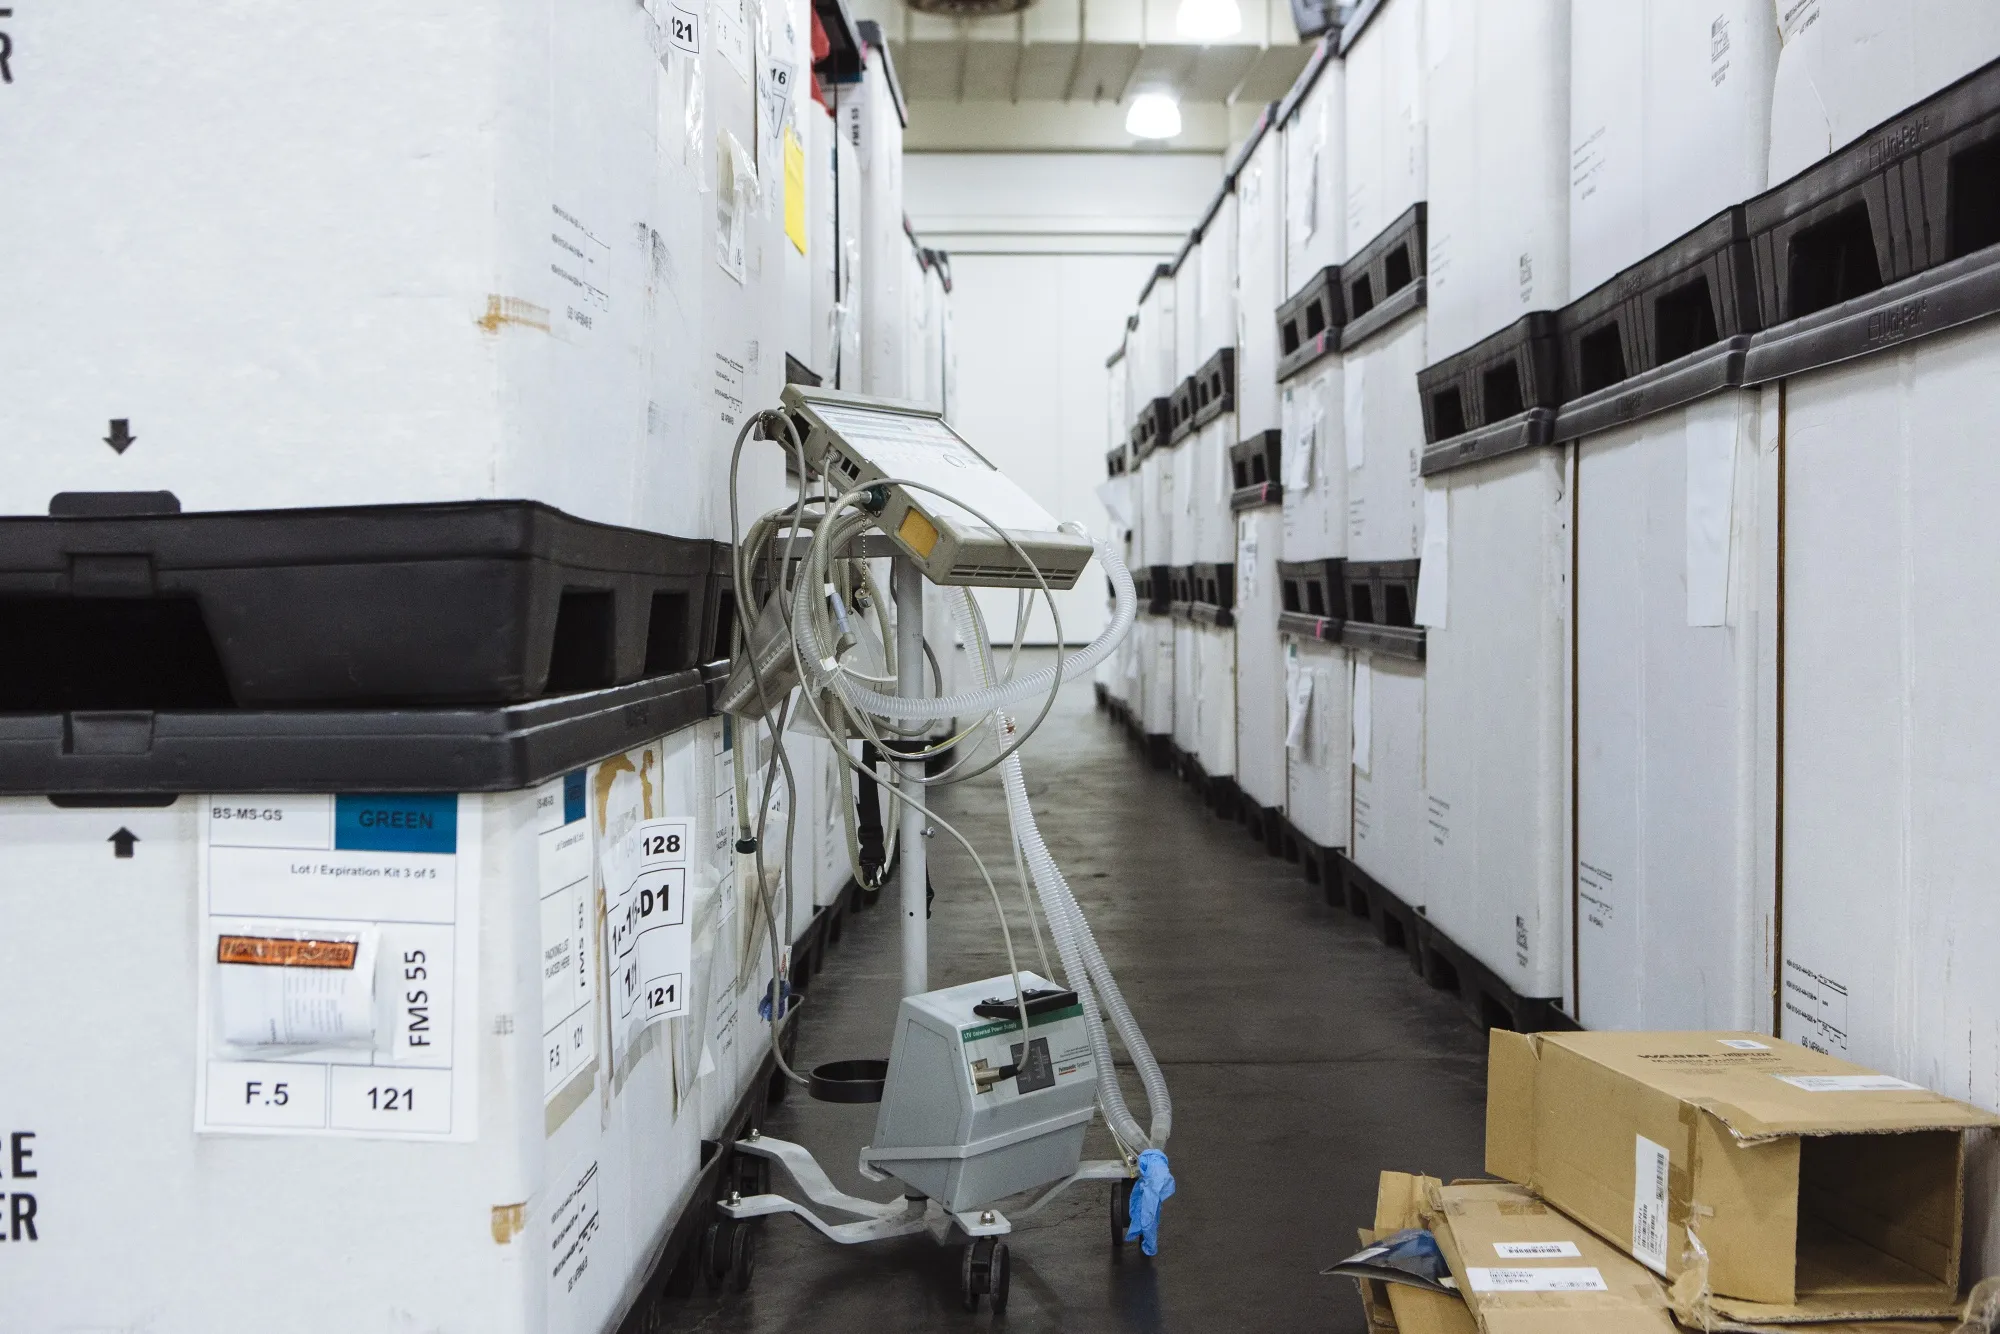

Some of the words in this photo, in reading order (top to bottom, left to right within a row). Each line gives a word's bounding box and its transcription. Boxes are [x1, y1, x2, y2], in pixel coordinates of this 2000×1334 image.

[671, 16, 693, 43] 121
[212, 806, 283, 822] BS-MS-GS
[358, 809, 433, 830] GREEN
[642, 834, 681, 857] 128
[290, 864, 310, 875] Lot
[320, 865, 380, 878] Expiration
[383, 867, 400, 878] Kit
[403, 868, 411, 878] 3
[413, 868, 426, 878] of
[404, 949, 428, 981] 55
[647, 984, 675, 1010] 121
[406, 989, 431, 1047] FMS
[573, 1024, 584, 1050] 121
[245, 1081, 290, 1106] F.5
[367, 1087, 415, 1111] 121
[0, 1131, 38, 1178] E
